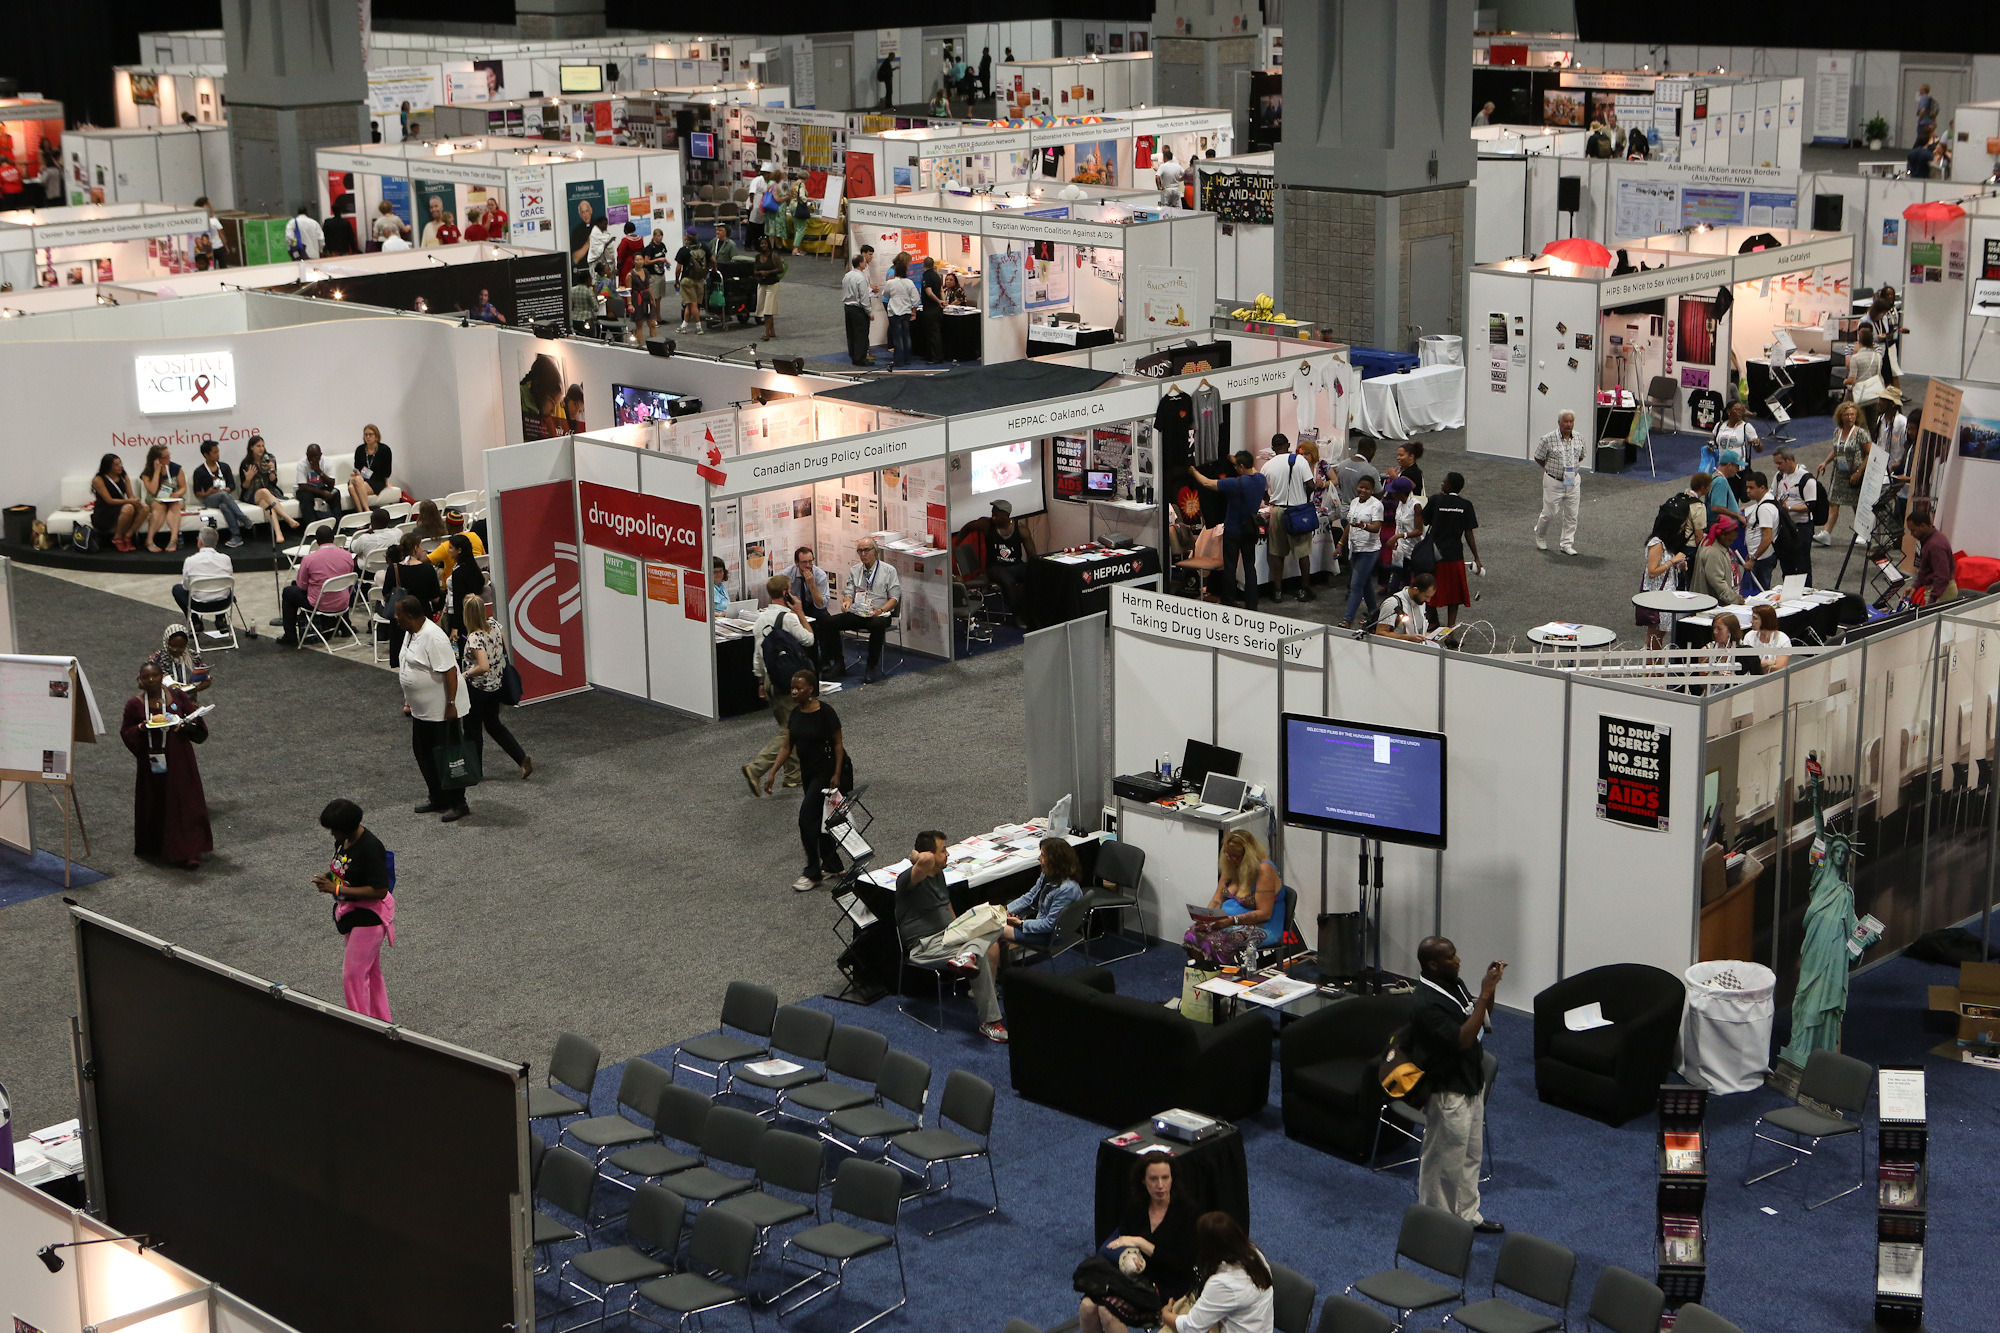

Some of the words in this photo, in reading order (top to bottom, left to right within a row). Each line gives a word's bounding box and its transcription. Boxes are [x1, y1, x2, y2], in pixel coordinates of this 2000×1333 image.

[971, 139, 995, 147] Education
[446, 169, 462, 178] Turning
[1683, 164, 1707, 173] Pacific:
[1708, 166, 1730, 174] Action
[1753, 168, 1781, 176] Borders
[1216, 175, 1241, 188] HOPE
[1246, 176, 1274, 189] FAITH
[1691, 175, 1733, 184] (Asia/Pacific
[1228, 189, 1249, 201] AND
[520, 206, 545, 218] GRACE
[877, 210, 888, 218] HIV
[889, 211, 916, 221] Networks
[933, 216, 952, 224] MENA
[953, 218, 974, 226] Region
[65, 229, 76, 237] for
[992, 222, 1019, 231] Egyptian
[1019, 224, 1043, 233] Women
[1044, 226, 1072, 236] Coalition
[1072, 229, 1096, 238] Against
[1097, 231, 1113, 239] AIDS
[1777, 256, 1789, 265] Asia
[1790, 252, 1811, 263] Catalyst
[1092, 265, 1114, 278] Thank
[1147, 279, 1188, 290] SMOOTHIES
[1606, 286, 1622, 297] HIPS:
[1623, 284, 1631, 294] Be
[1632, 281, 1646, 292] Nice
[1646, 281, 1654, 290] to
[1654, 279, 1665, 288] Sex
[1666, 273, 1690, 286] Workers
[1690, 273, 1695, 282] &
[1695, 271, 1709, 282] Drug
[1710, 268, 1726, 279] Users
[1147, 363, 1164, 378] AIDS
[1227, 374, 1259, 389] Housing
[1261, 370, 1287, 382] Works
[1007, 415, 1047, 429] HEPPAC:
[1049, 408, 1090, 423] Oakland,
[1091, 403, 1105, 414] CA
[112, 429, 212, 450] Networking
[219, 426, 261, 442] Zone
[1066, 441, 1082, 449] DRUG
[753, 461, 801, 478] Canadian
[804, 455, 828, 469] Drug
[831, 449, 861, 464] Policy
[863, 441, 907, 458] Coalition
[1057, 447, 1082, 458] USERS?
[1056, 456, 1067, 466] NO
[1068, 458, 1082, 467] SEX
[1057, 465, 1082, 473] WORKERS?
[1057, 478, 1083, 491] AIDS
[588, 501, 696, 546] drugpolicy.ca
[605, 556, 624, 569] WHY?
[1093, 563, 1131, 580] HEPPAC
[1122, 592, 1152, 609] Harm
[1156, 599, 1218, 622] Reduction
[1221, 612, 1230, 625] &
[1234, 614, 1265, 633] Drug
[1130, 612, 1168, 633] Taking
[1172, 621, 1201, 639] Drug
[1206, 627, 1240, 645] Users
[1243, 635, 1302, 659] Seriosly
[1306, 726, 1327, 734] SELECTED
[1352, 732, 1374, 741] HUNGARIA
[1608, 723, 1625, 736] NO
[1628, 727, 1661, 742] DRUG
[1608, 734, 1659, 754] USERS?
[1607, 750, 1629, 765] NO
[1633, 755, 1660, 771] SEX
[1608, 763, 1660, 781] WORKERS?
[1608, 776, 1619, 784] NO
[1608, 784, 1660, 810] AIDS
[1337, 808, 1354, 816] ENGLISH
[1354, 810, 1376, 819] SUBTITLES
